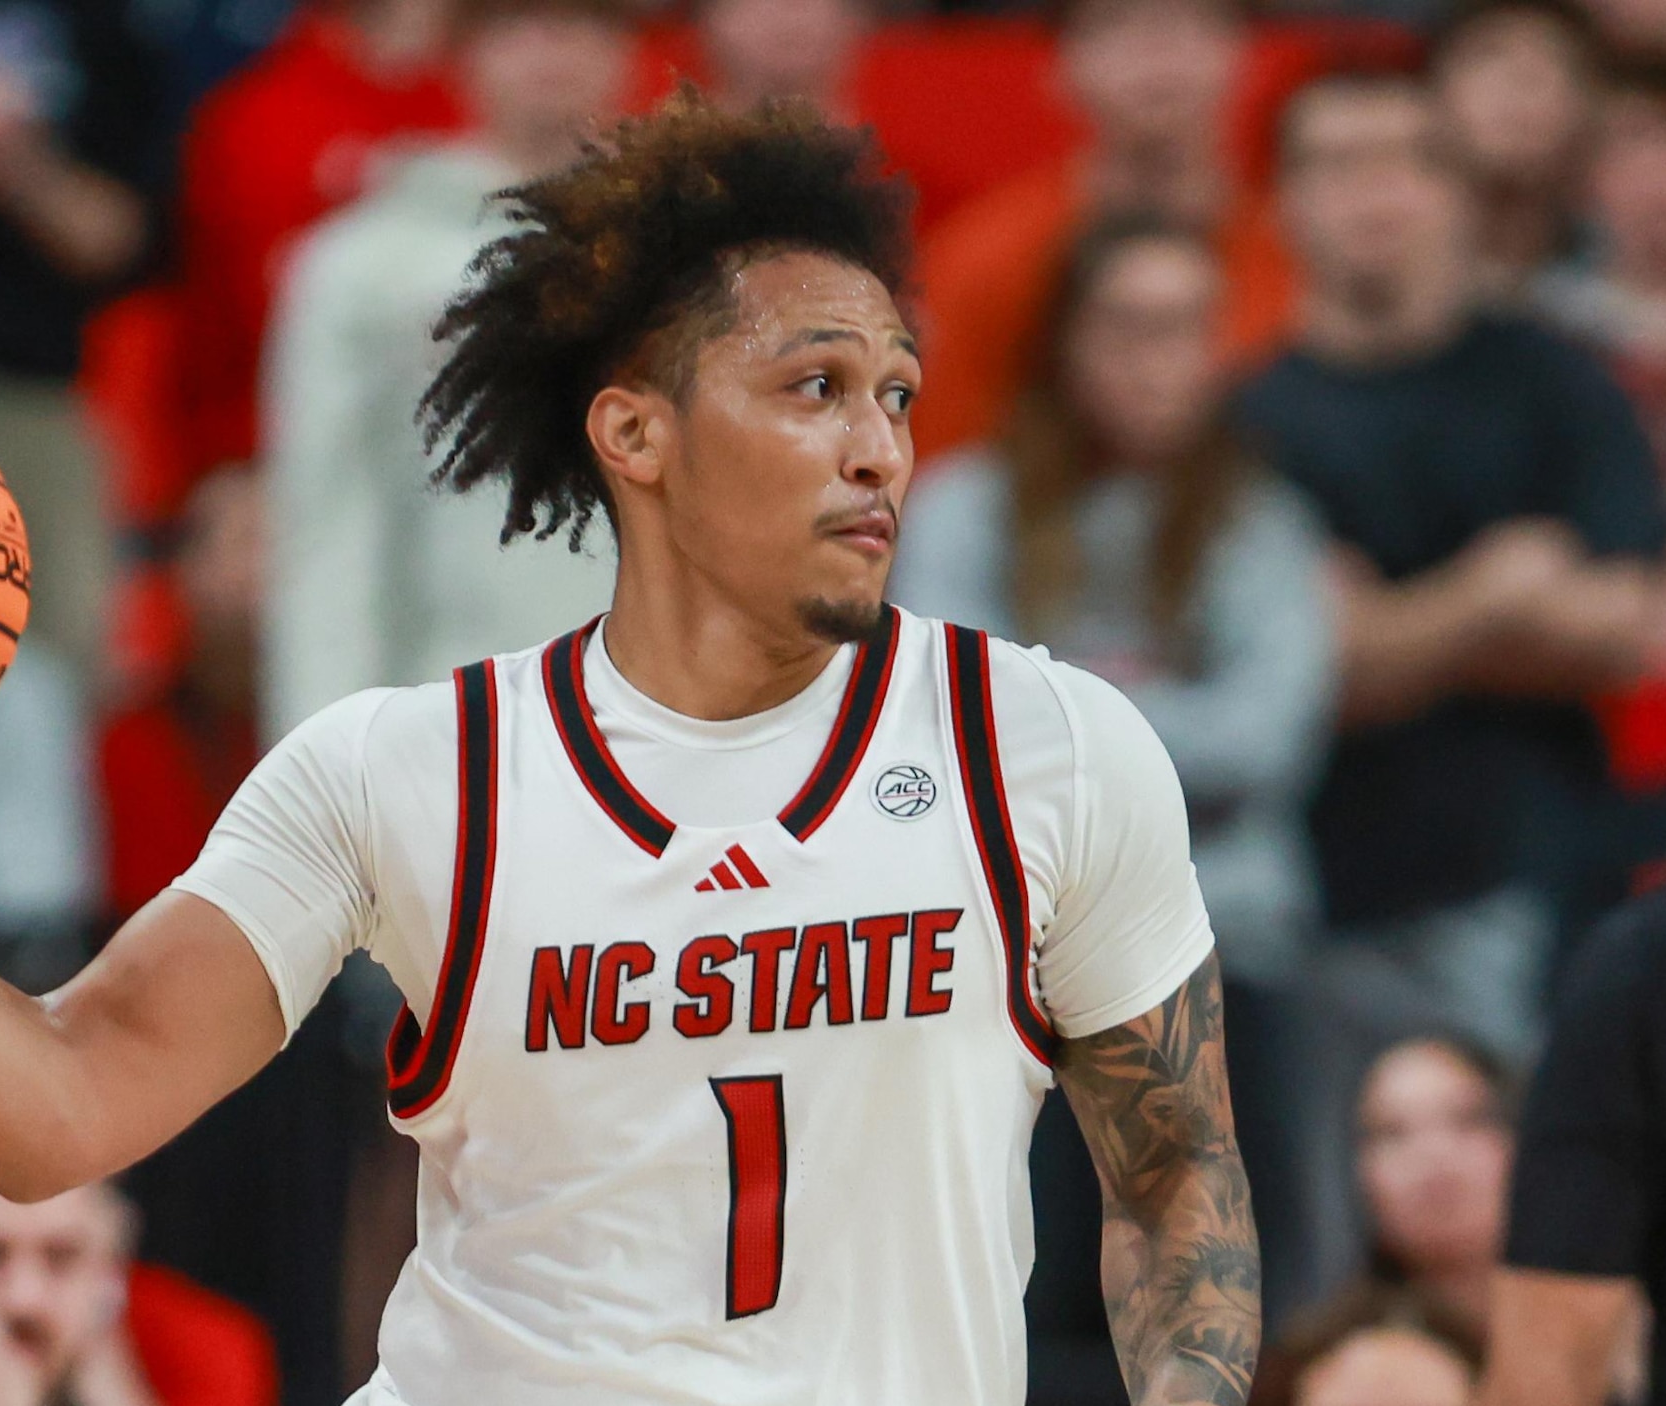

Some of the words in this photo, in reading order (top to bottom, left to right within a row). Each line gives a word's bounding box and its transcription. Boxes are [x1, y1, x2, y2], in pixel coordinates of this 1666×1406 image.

[882, 780, 932, 796] ACC
[525, 942, 656, 1053] NC
[672, 907, 965, 1040] STATE
[707, 1073, 788, 1323] 1
